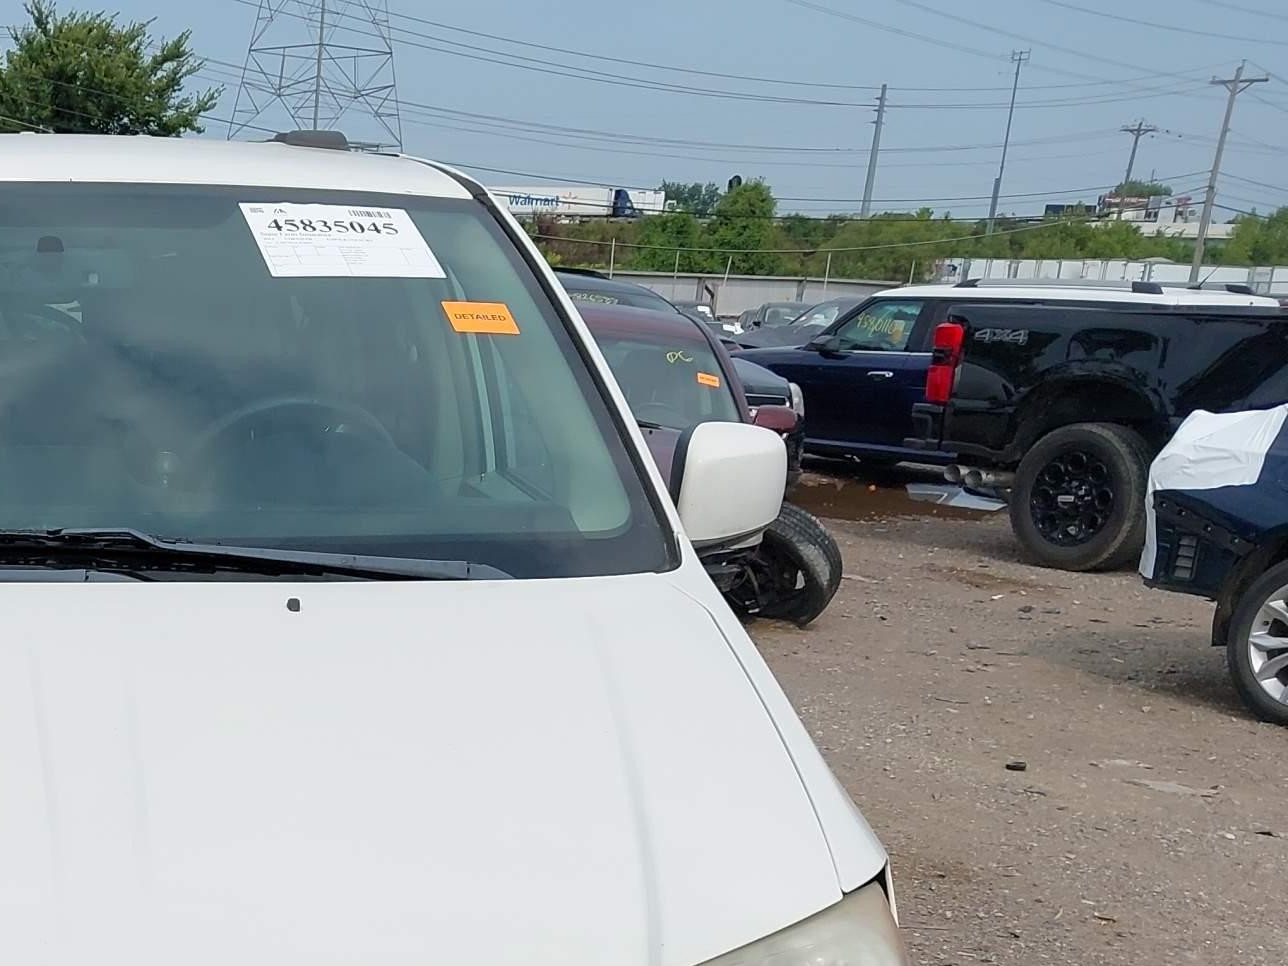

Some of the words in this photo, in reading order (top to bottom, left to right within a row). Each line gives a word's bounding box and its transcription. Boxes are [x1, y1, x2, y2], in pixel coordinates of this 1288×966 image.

[509, 195, 560, 206] Walmart
[267, 218, 400, 236] 45835045
[453, 312, 507, 322] DETAILED
